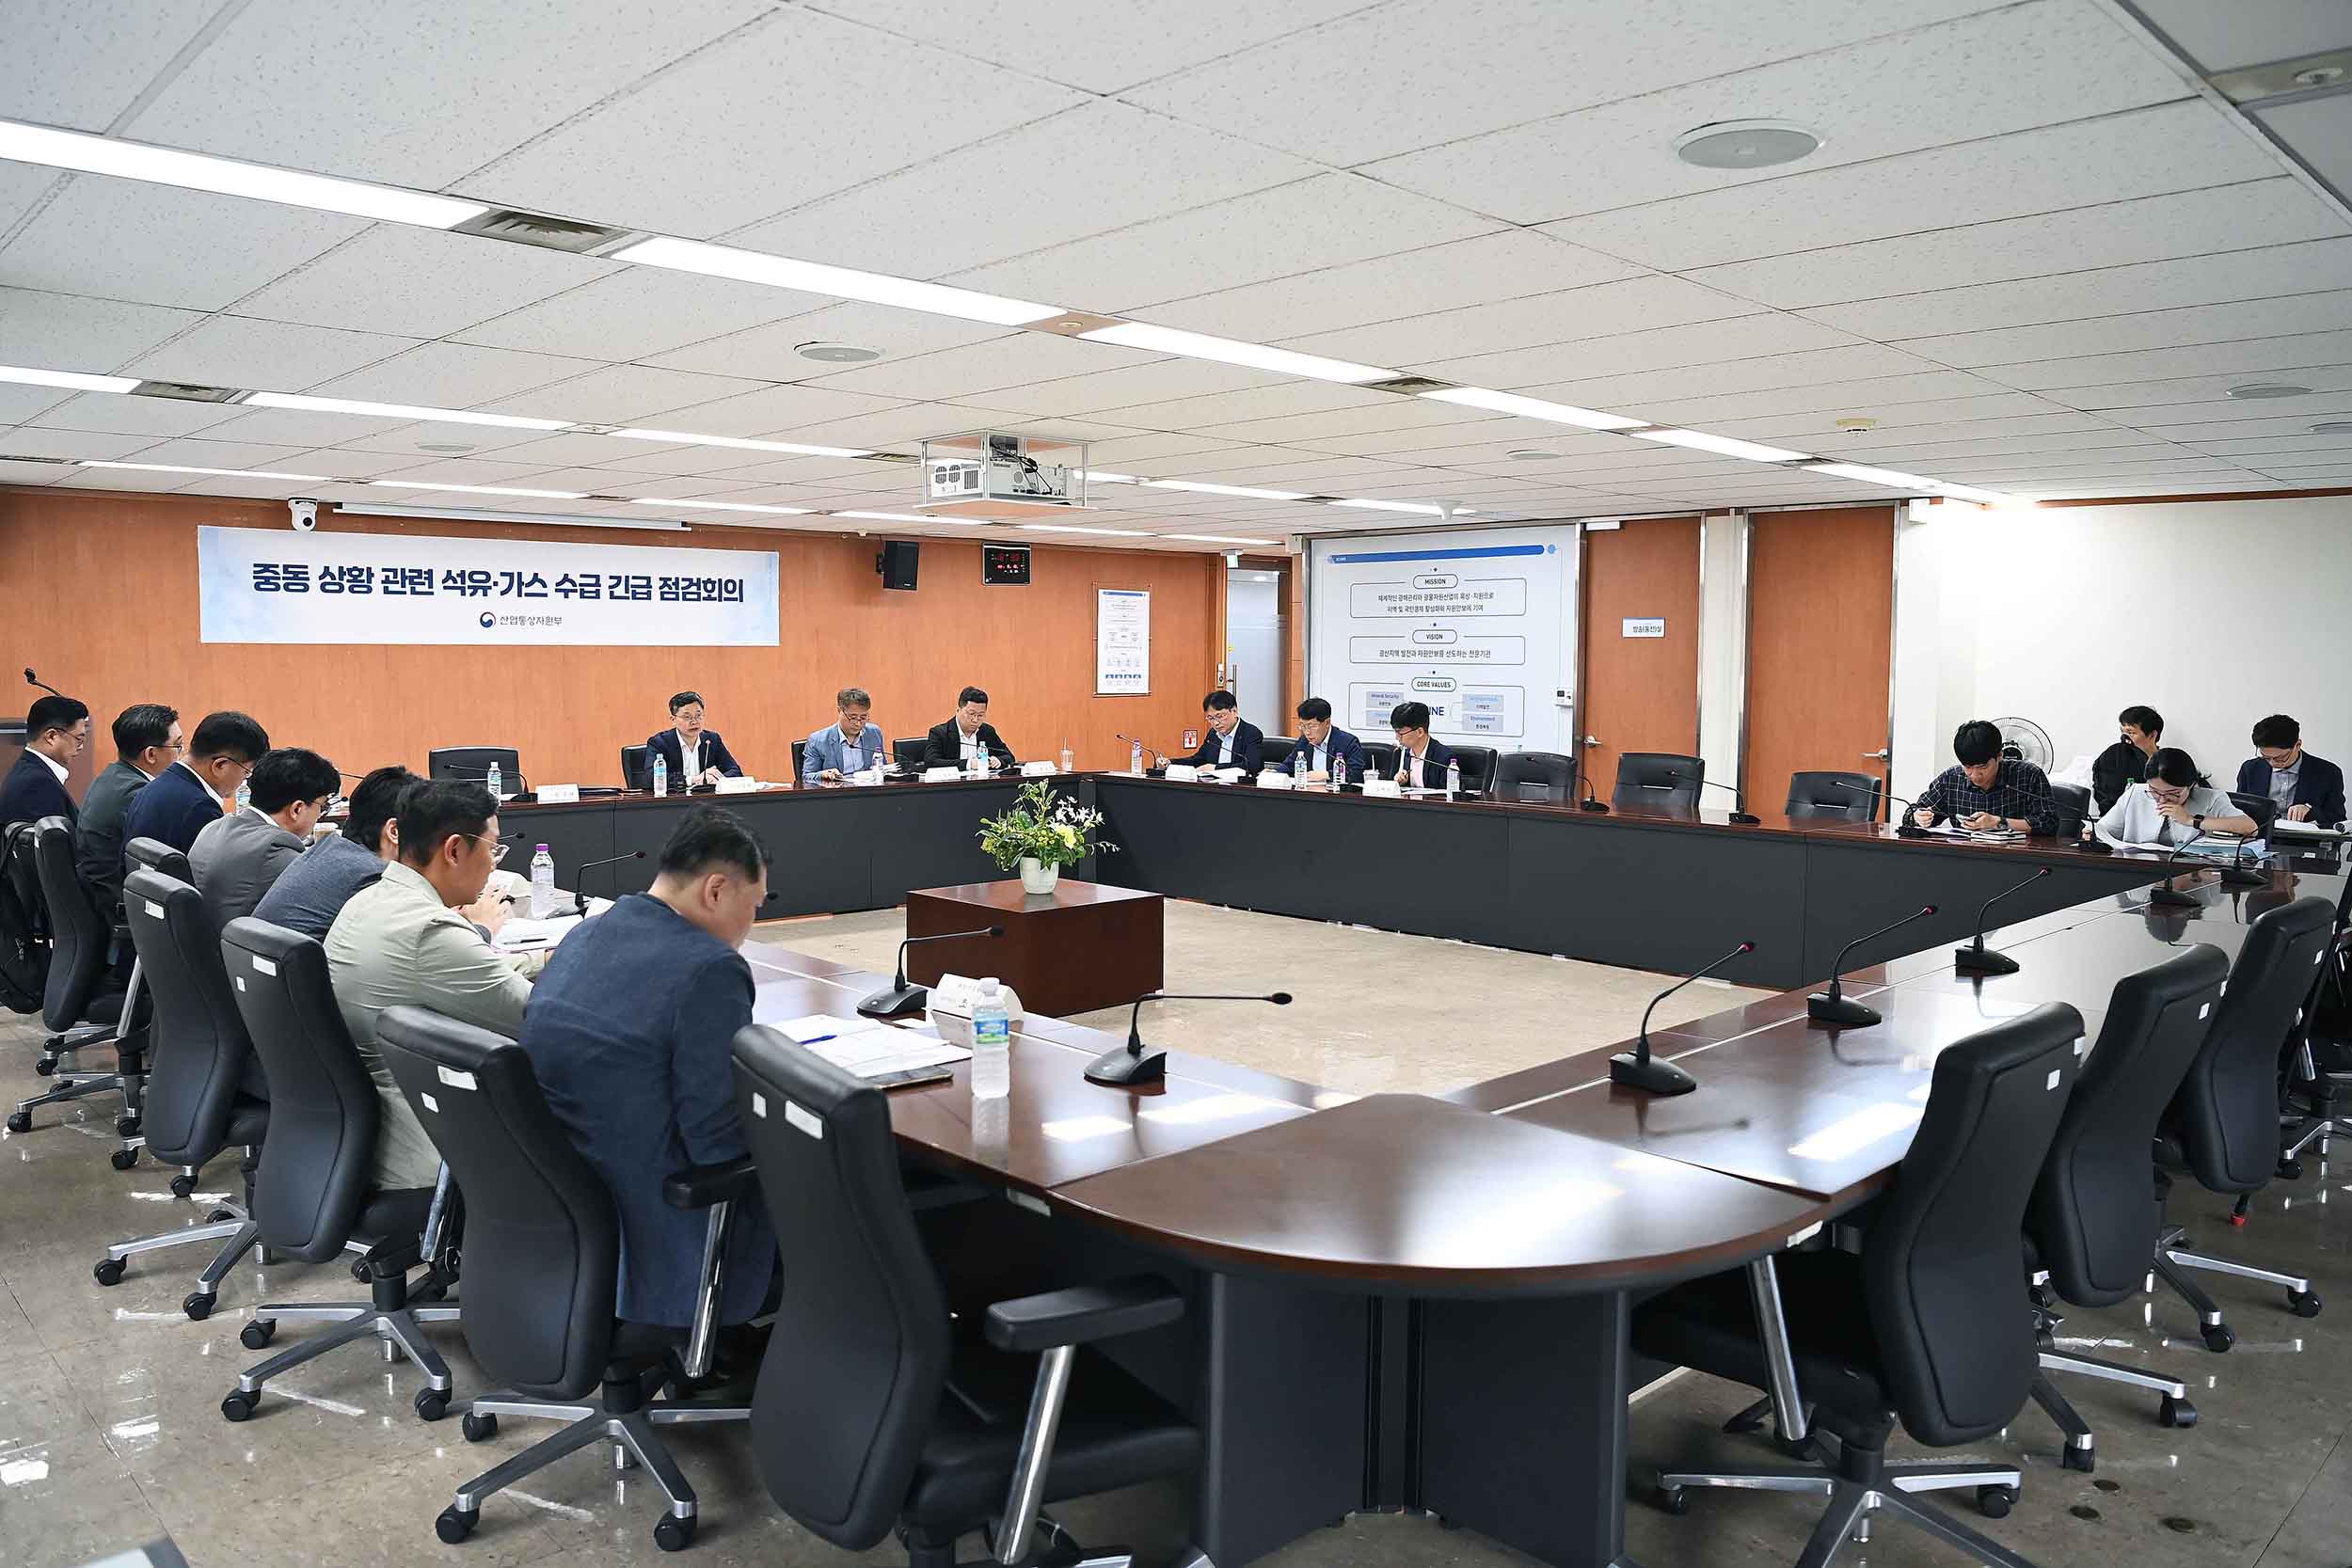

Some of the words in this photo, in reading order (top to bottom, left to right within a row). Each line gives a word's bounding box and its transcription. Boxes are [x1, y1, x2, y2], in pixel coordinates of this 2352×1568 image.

[253, 563, 310, 594] 중동
[318, 565, 374, 594] 상황
[381, 567, 435, 595] 관련
[441, 569, 548, 598] 석유·가스
[554, 573, 601, 599] 수급
[608, 575, 653, 601] 긴급
[659, 577, 744, 603] 점검회의
[500, 615, 563, 626] 산업통상자원부
[1429, 706, 1445, 716] INE
